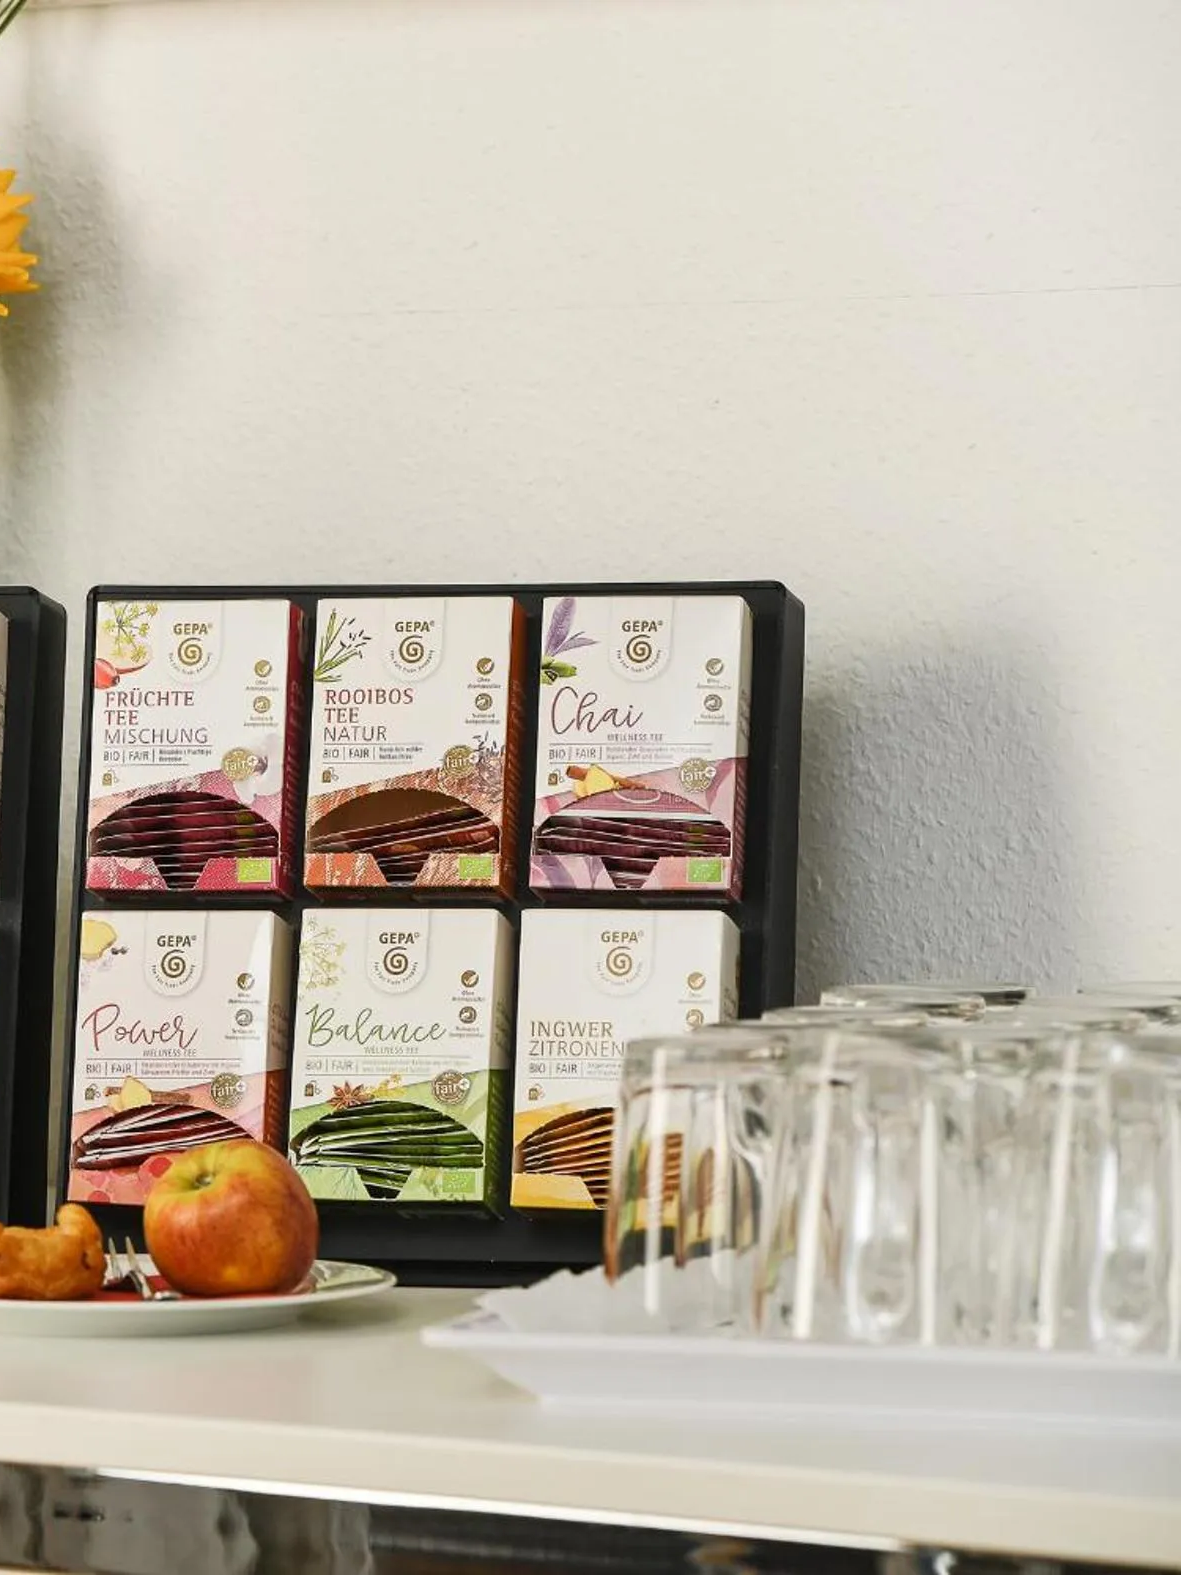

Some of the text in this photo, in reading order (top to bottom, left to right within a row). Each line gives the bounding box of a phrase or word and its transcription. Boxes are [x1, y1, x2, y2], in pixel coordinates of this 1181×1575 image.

[104, 688, 195, 707] FRÜCHTE
[325, 688, 415, 706] ROOIBOS
[103, 709, 139, 726] TEE
[324, 707, 360, 725] TEE
[550, 685, 644, 735] Chai
[102, 728, 210, 745] MISCHUNG
[323, 725, 388, 742] NATUR
[575, 748, 597, 760] FAIR
[81, 1003, 199, 1053] Power
[304, 1003, 448, 1048] Balance
[530, 1020, 613, 1039] INGWER
[555, 1062, 579, 1074] FAIR
